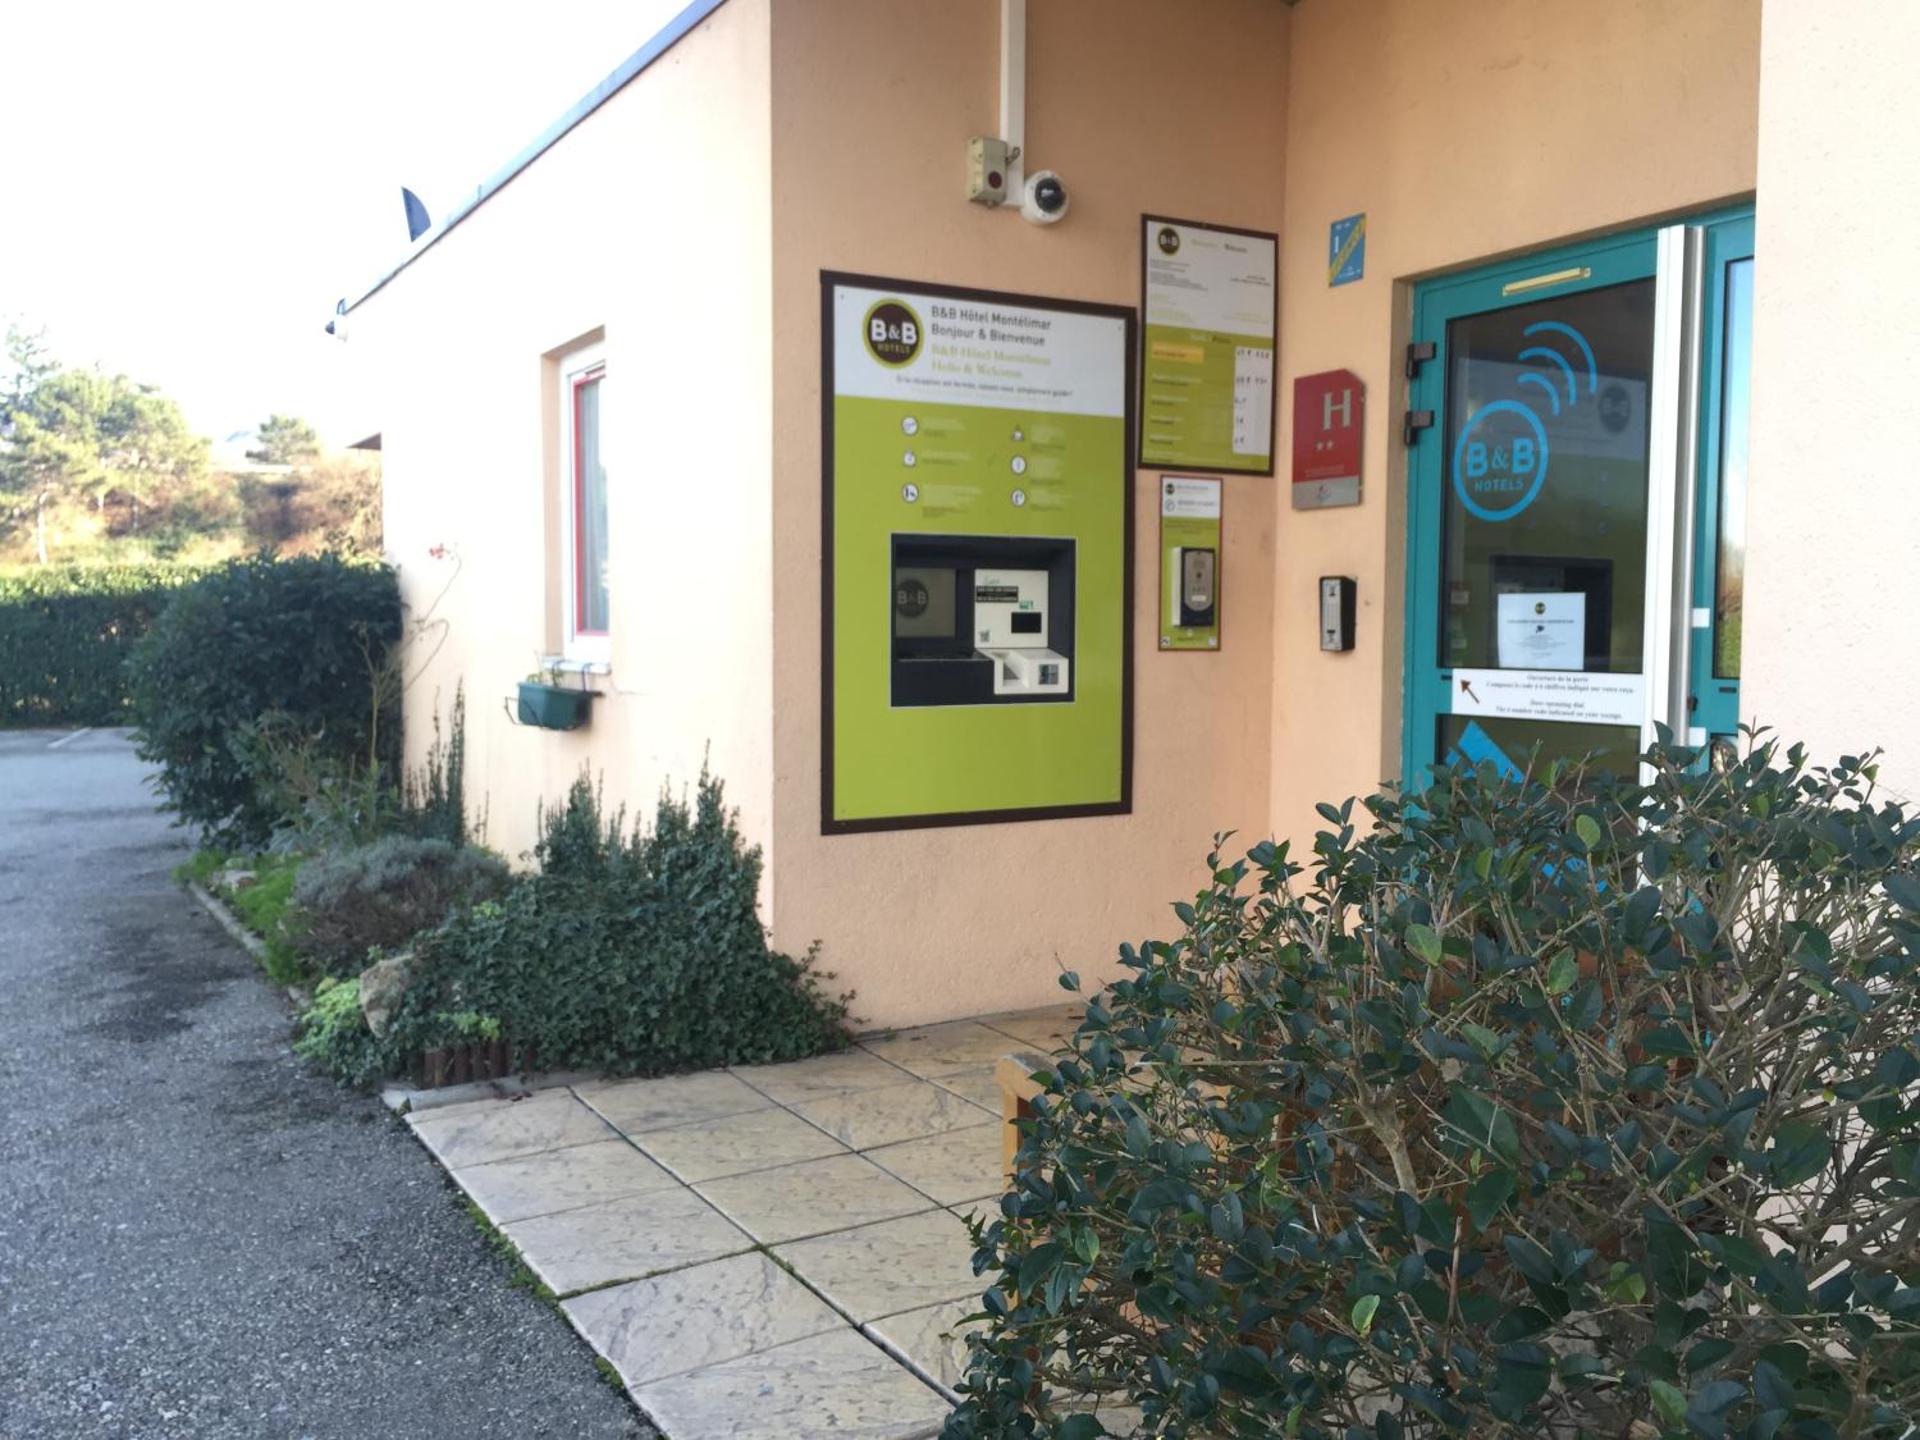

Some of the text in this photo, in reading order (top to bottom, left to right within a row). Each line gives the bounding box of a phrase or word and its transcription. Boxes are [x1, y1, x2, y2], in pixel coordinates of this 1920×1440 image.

[931, 305, 1051, 330] B&B Hôtel Montélimar
[871, 318, 917, 345] B&B
[931, 322, 1045, 347] Bonjour & Bienvenue
[1322, 388, 1352, 431] H
[1467, 438, 1535, 478] B&B
[1474, 479, 1524, 493] HOTELS
